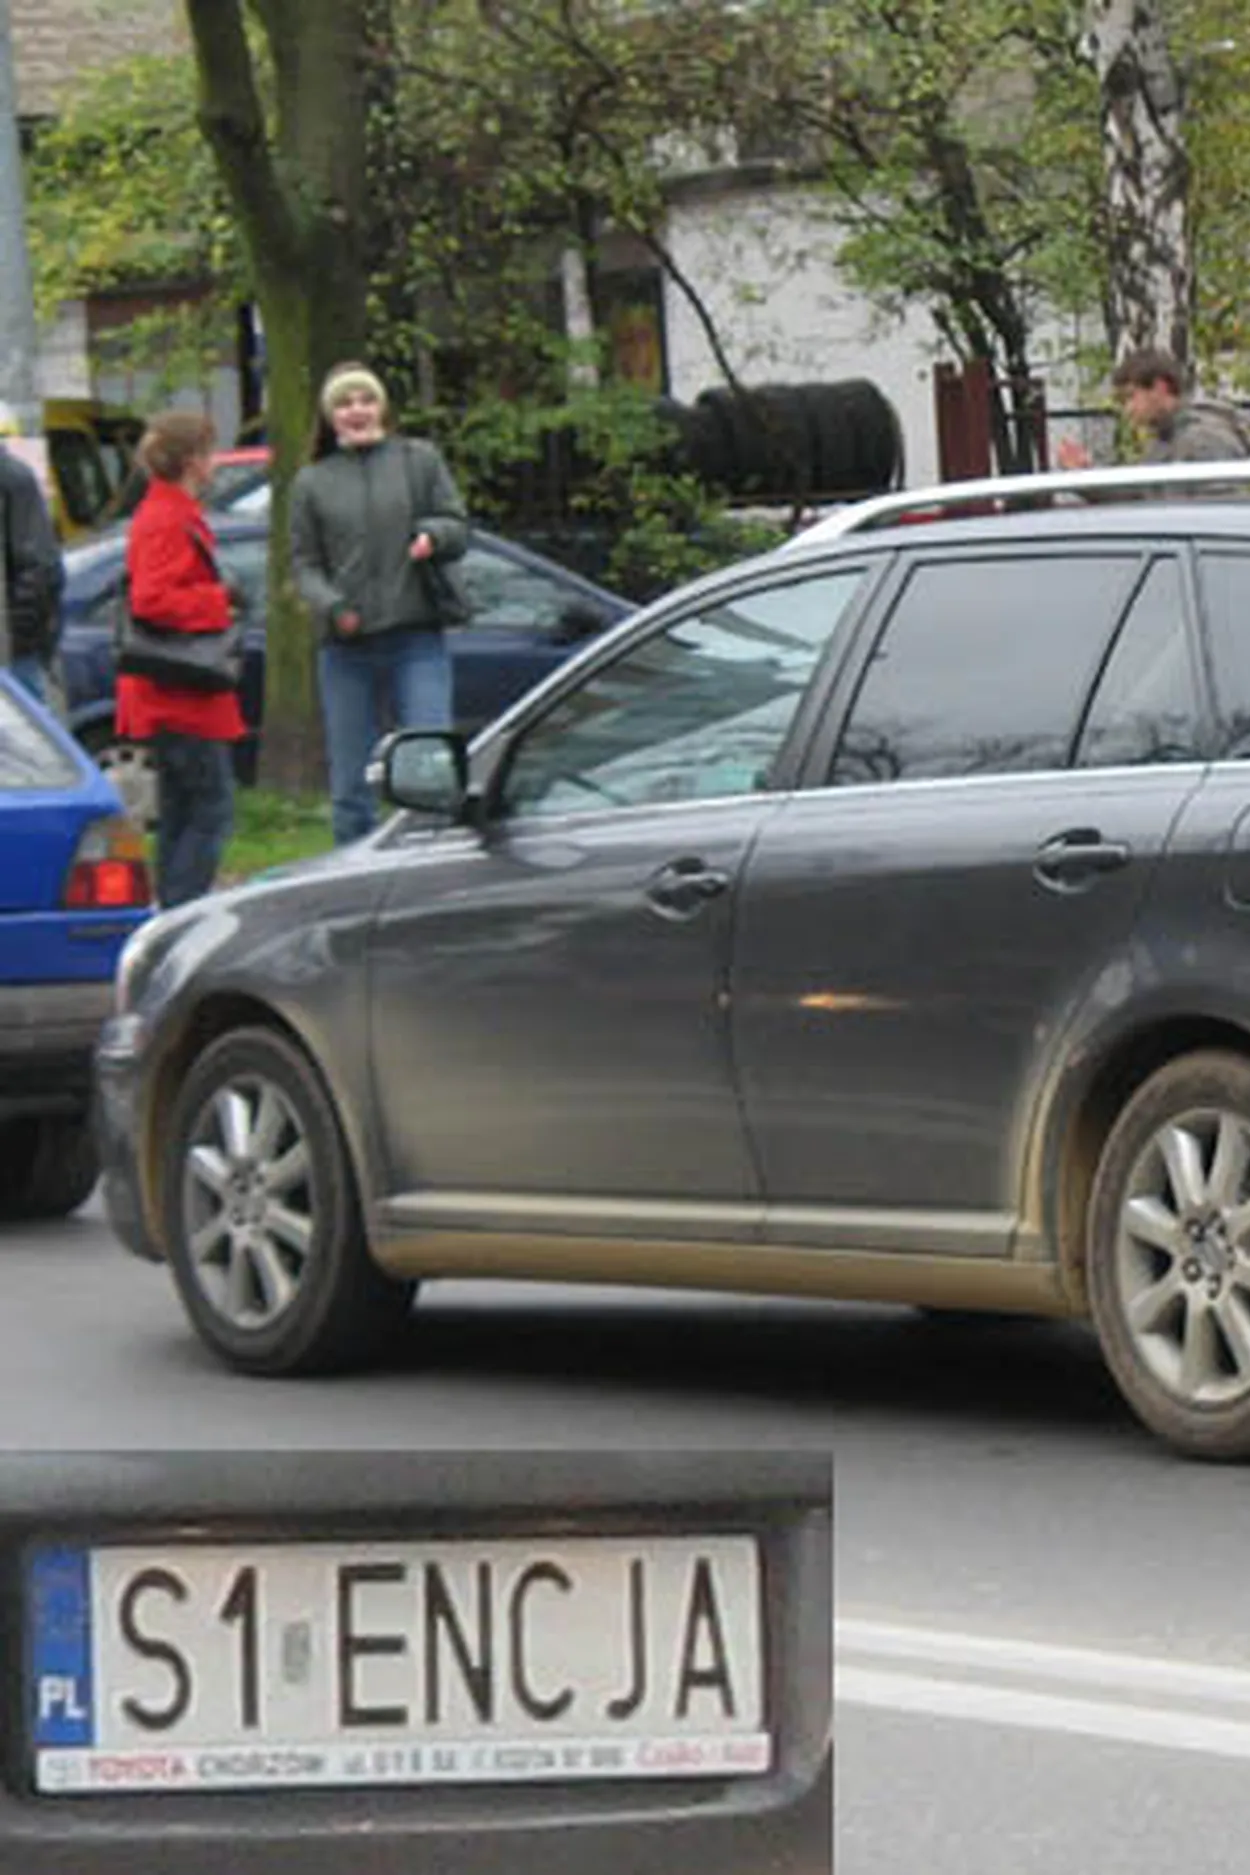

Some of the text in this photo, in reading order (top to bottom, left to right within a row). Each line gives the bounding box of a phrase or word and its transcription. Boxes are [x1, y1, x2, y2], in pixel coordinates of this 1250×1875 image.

[40, 1676, 88, 1719] PL
[117, 1556, 737, 1731] S1 ENCJA
